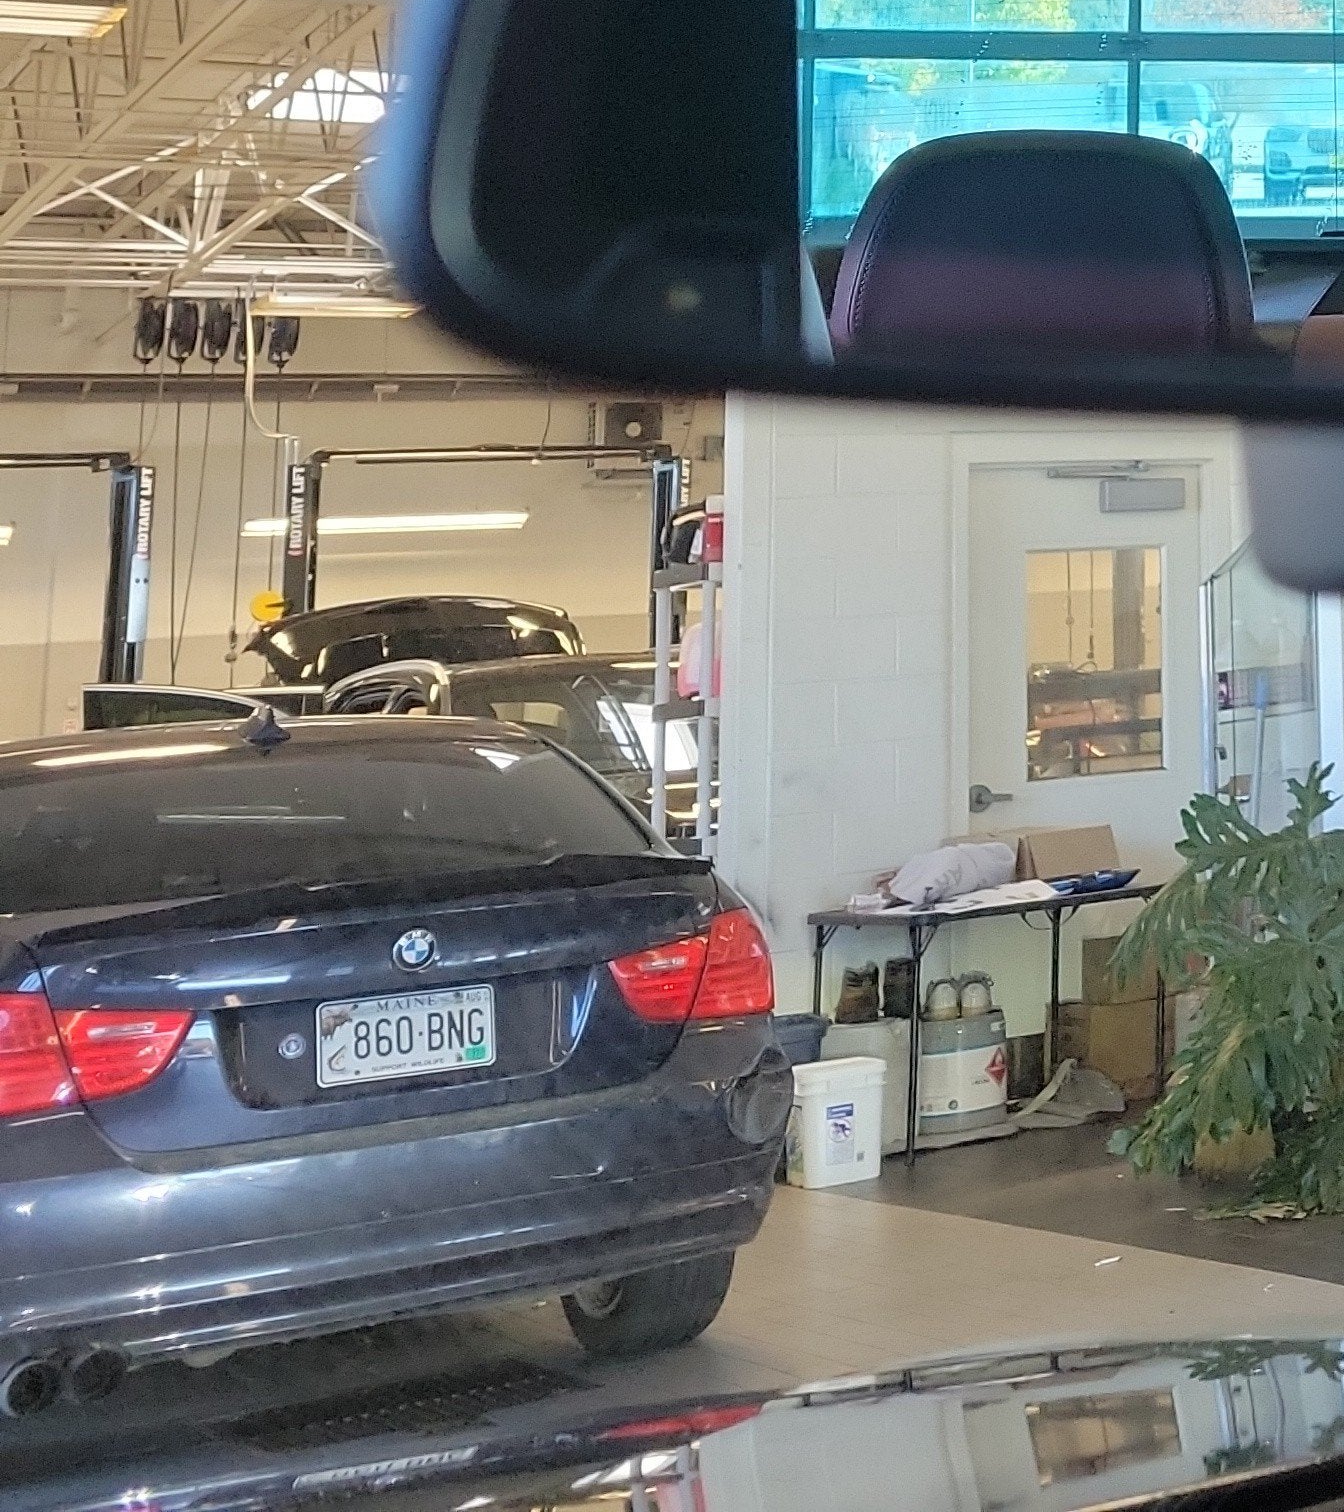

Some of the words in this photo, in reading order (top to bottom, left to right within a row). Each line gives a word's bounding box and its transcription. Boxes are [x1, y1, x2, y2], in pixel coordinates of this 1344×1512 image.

[139, 467, 154, 496] LIFT
[291, 465, 306, 494] LIFT
[136, 497, 152, 552] ROTARY
[377, 995, 437, 1013] MAINE
